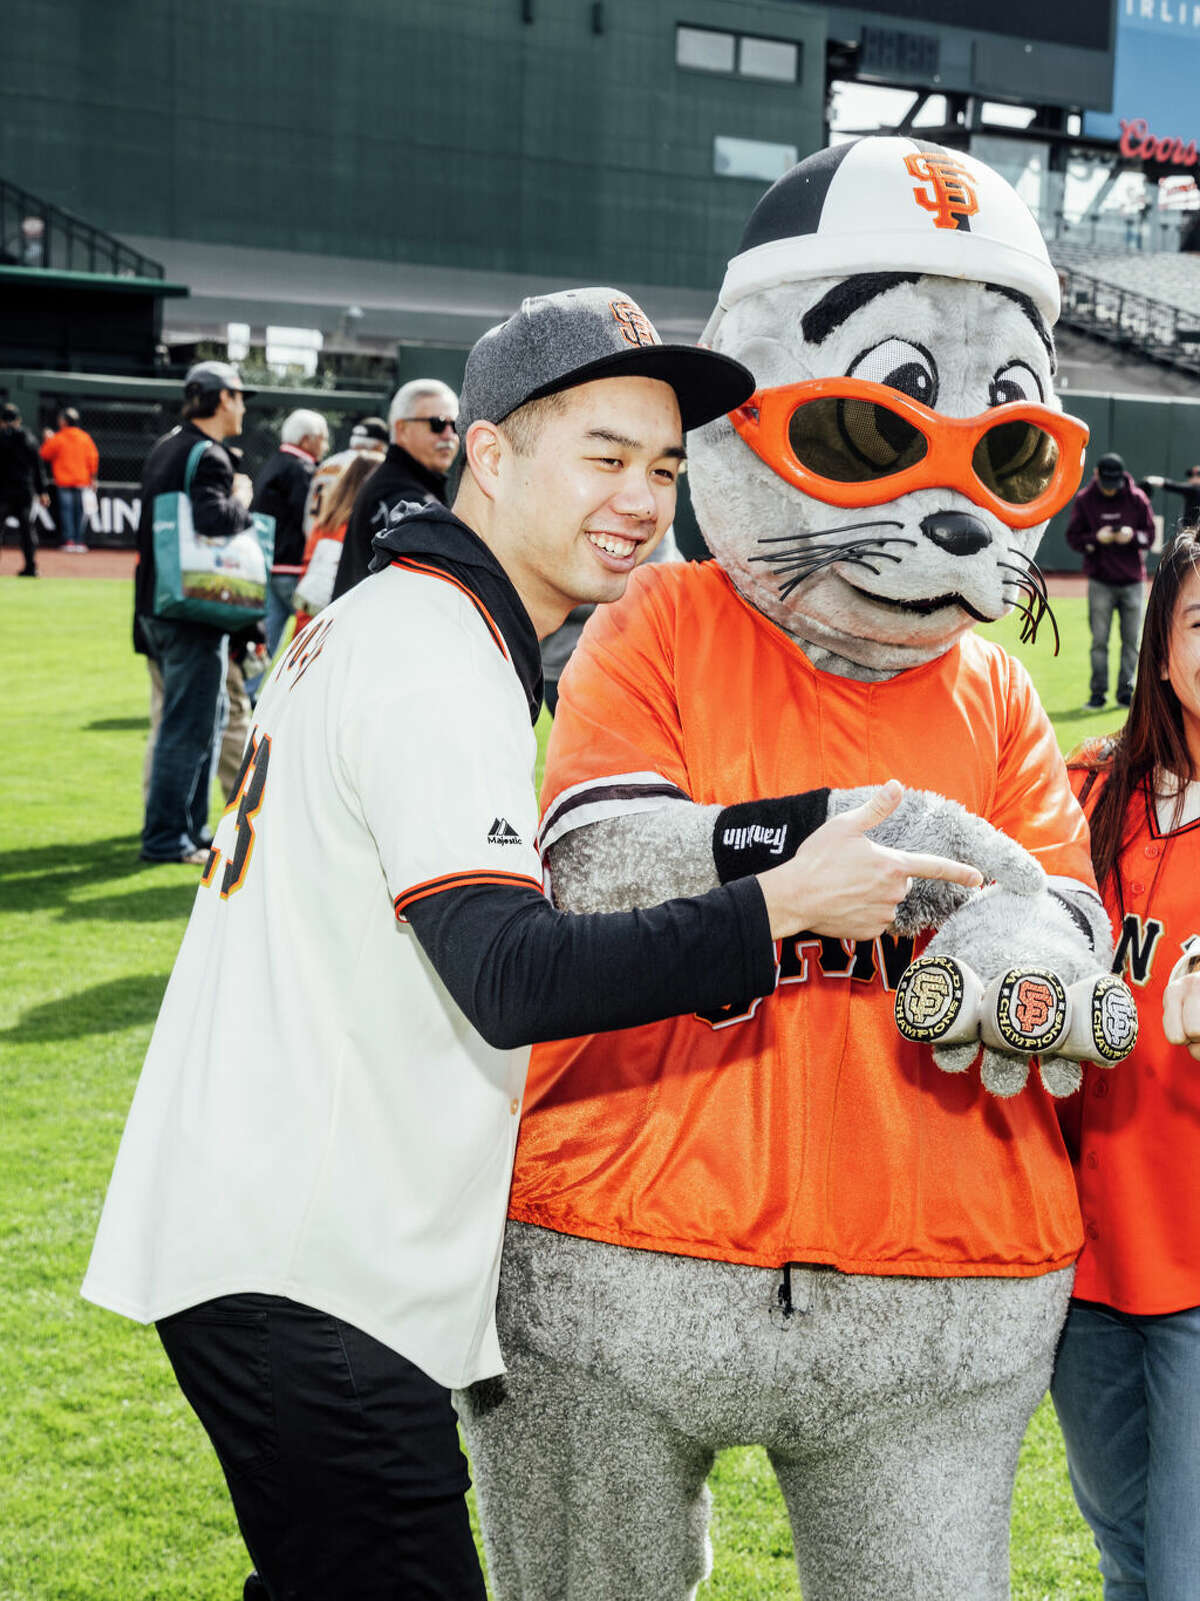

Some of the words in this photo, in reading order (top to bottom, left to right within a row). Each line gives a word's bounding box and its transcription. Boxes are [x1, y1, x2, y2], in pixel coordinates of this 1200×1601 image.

[1119, 118, 1199, 166] Coors
[903, 151, 981, 230] SF
[487, 836, 523, 847] Majestic
[722, 823, 789, 855] franklin
[904, 956, 962, 994] WORLD
[910, 971, 950, 1025] SF
[1006, 967, 1066, 1001] WORLD
[895, 990, 961, 1041] CHAMPIONS
[1000, 998, 1065, 1050] CHAMPIONS
[1015, 980, 1054, 1034] SF
